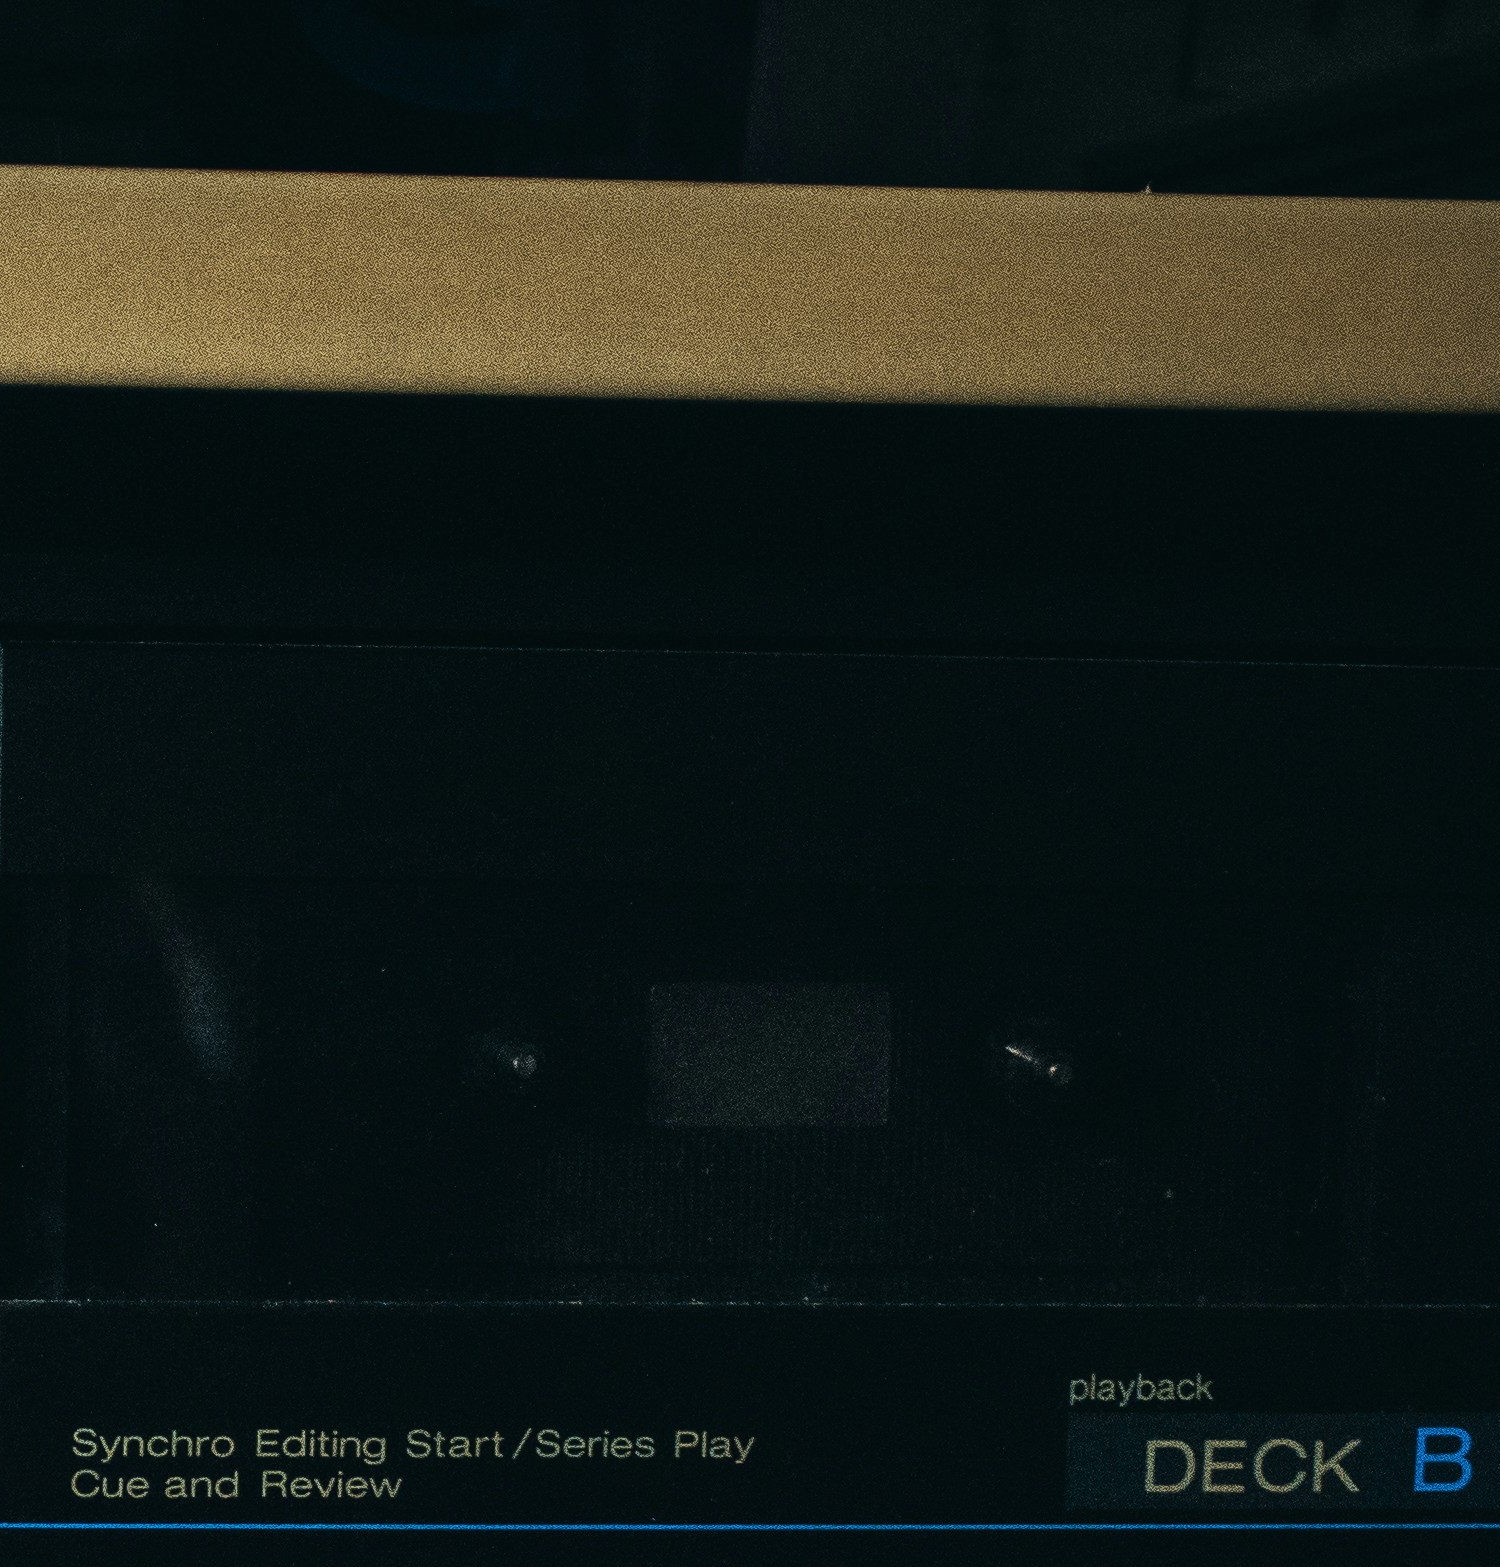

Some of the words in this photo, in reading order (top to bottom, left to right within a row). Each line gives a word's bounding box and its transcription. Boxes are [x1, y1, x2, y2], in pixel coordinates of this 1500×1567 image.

[1069, 1374, 1212, 1407] playback
[72, 1427, 235, 1463] Synchro
[256, 1429, 386, 1465] Editing
[674, 1430, 755, 1464] Play
[1145, 1438, 1360, 1493] DECK
[1414, 1427, 1472, 1492] B
[71, 1469, 149, 1499] Cue
[165, 1471, 239, 1499] and
[261, 1470, 401, 1498] Review
